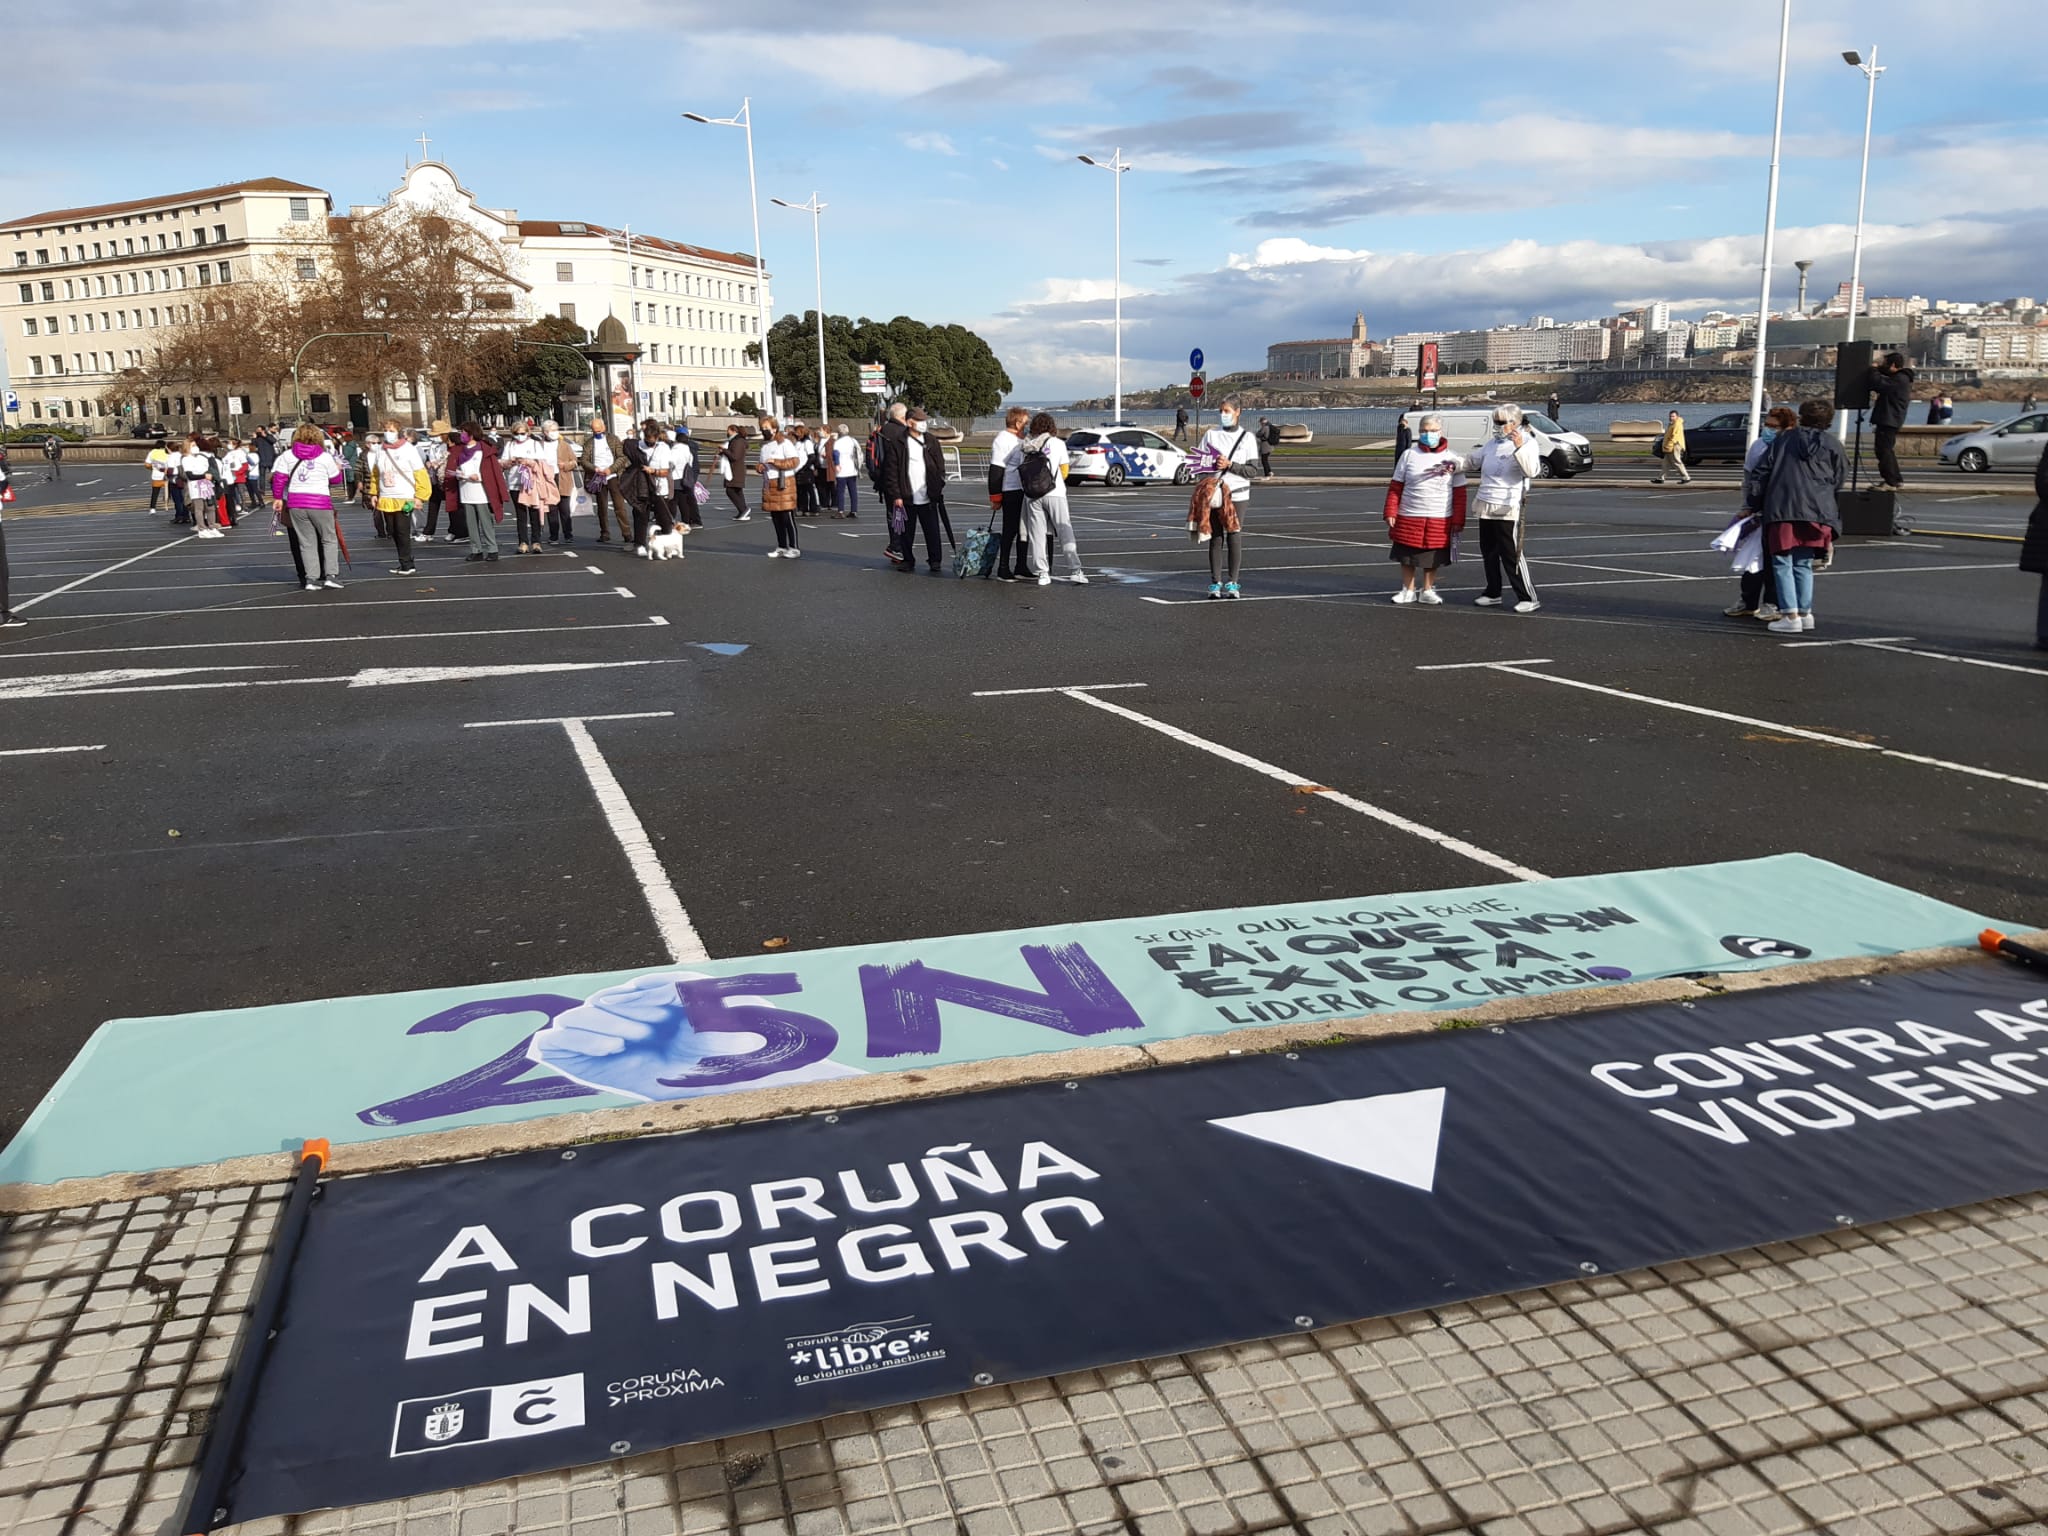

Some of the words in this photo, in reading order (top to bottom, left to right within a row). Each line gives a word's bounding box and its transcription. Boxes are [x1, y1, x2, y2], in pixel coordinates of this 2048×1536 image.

[5, 391, 17, 407] P
[1237, 917, 1311, 934] QUE
[1312, 905, 1421, 926] NON
[1286, 922, 1475, 954] QUE
[1470, 906, 1640, 939] NON
[1398, 985, 1450, 1002] O
[1590, 1020, 1992, 1098] CONTRA
[1649, 1048, 2048, 1144] VIOLENC
[417, 1225, 518, 1283] A
[570, 1141, 1102, 1258] CORUÑA
[405, 1274, 591, 1359] EN
[797, 1336, 839, 1347] coruña
[606, 1368, 702, 1393] CORUÑA
[794, 1373, 810, 1383] de
[813, 1360, 879, 1380] violencias
[882, 1349, 946, 1367] machistas
